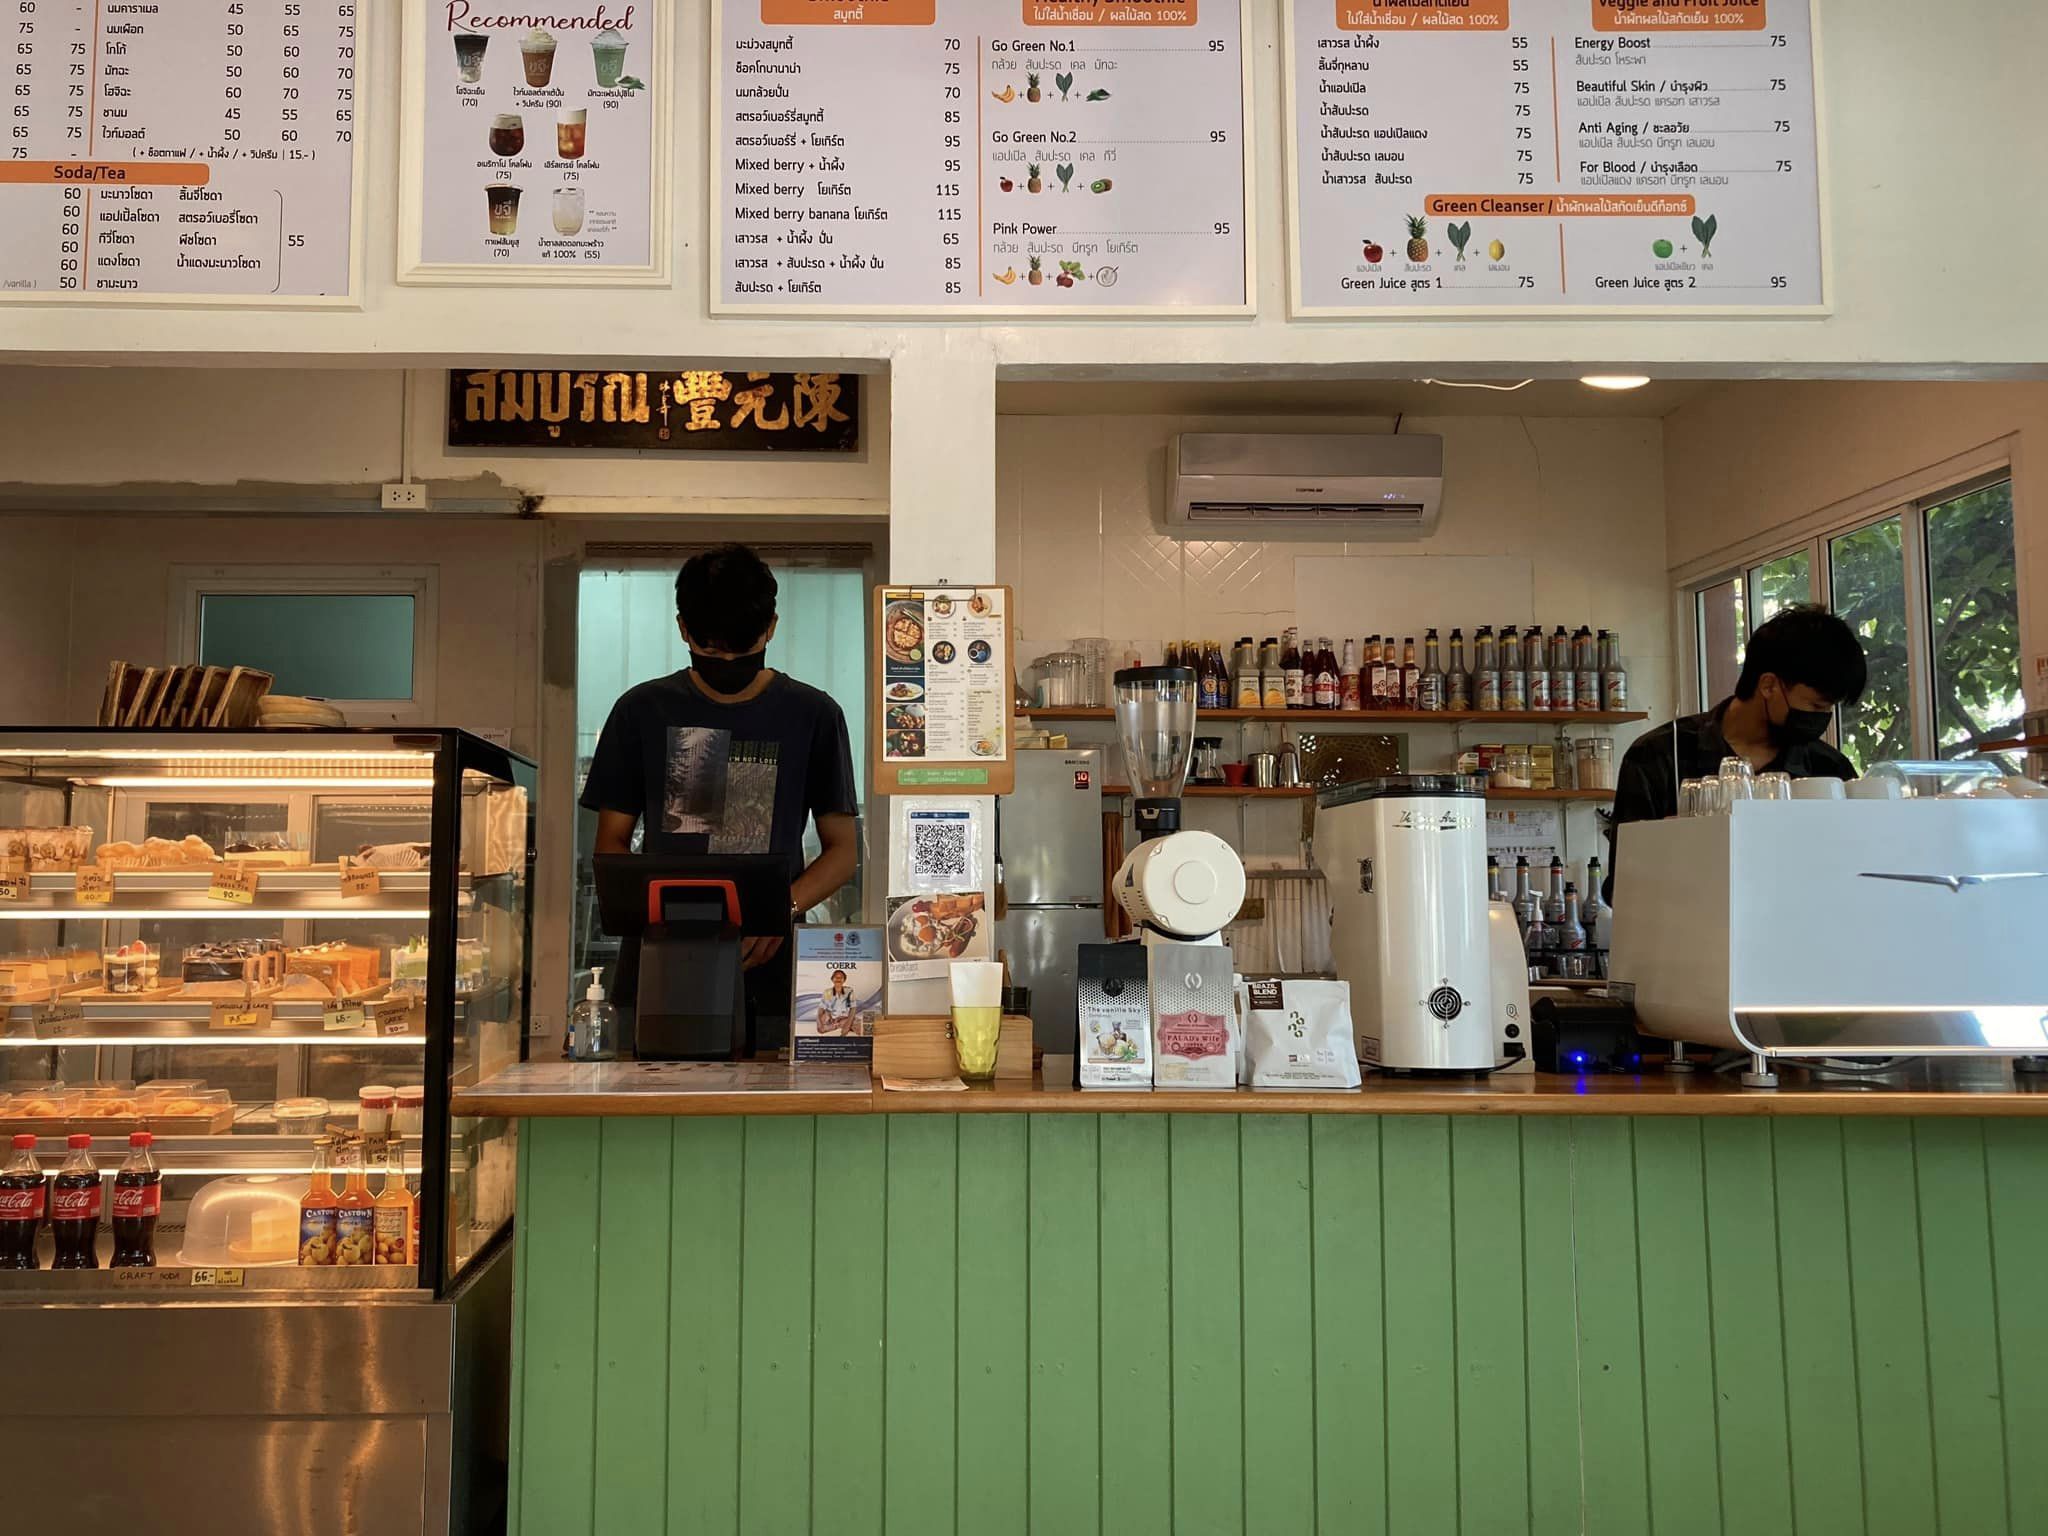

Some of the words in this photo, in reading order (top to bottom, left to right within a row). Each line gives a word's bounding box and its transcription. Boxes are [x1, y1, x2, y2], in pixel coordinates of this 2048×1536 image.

[108, 5, 158, 13] นมคาราเมล
[228, 4, 243, 14] 45
[1111, 7, 1151, 22] ผลไม้สด
[1157, 10, 1186, 22] 100%
[445, 0, 635, 33] Recommended
[1423, 11, 1463, 24] ผลไม้สด
[1469, 15, 1500, 24] 100%
[1712, 13, 1744, 24] 100%
[107, 24, 143, 33] นมเผือก
[228, 24, 243, 35] 50
[736, 36, 793, 52] มะม่วงสมูทตี้
[945, 39, 960, 50] 70
[992, 40, 1007, 51] Go
[1012, 40, 1045, 51] Green
[1050, 40, 1075, 51] No.1
[1208, 40, 1224, 52] 95
[1318, 40, 1349, 48] เสาวรส
[1354, 34, 1379, 48] น้ำผึ้ง
[1513, 37, 1528, 48] 55
[1575, 37, 1614, 51] Energy
[1619, 37, 1650, 48] Boost
[1771, 36, 1786, 46] 75
[106, 42, 126, 54] โกโก้
[227, 45, 242, 56] 50
[105, 65, 128, 75] มัทฉะ
[227, 66, 242, 77] 50
[945, 63, 960, 74] 75
[1319, 57, 1369, 74] ลิ้นจี่กุหลาบ
[1513, 60, 1528, 72] 55
[104, 84, 130, 96] โฮจิฉะ
[226, 87, 241, 98] 60
[736, 84, 788, 97] นมกล้วยปั่น
[945, 87, 960, 98] 70
[1320, 79, 1366, 93] น้ำแอปเปิล
[1514, 83, 1529, 93] 75
[1577, 80, 1626, 91] Beautiful
[1631, 80, 1656, 93] Skin
[1770, 79, 1786, 90] 75
[462, 98, 477, 107] (70)
[546, 98, 561, 109] (90)
[603, 100, 619, 109] (90)
[103, 109, 127, 117] ชานม
[225, 108, 240, 119] 45
[736, 108, 824, 125] สตรอว์เบอร์รี่สมูทตี้
[945, 111, 960, 122] 85
[102, 125, 145, 138] ไวท์มอลต์
[225, 129, 240, 140] 50
[1321, 124, 1369, 138] น้ำสับปะรด
[1374, 128, 1427, 138] แอปเปิลแดง
[1516, 128, 1531, 139] 75
[1579, 122, 1601, 133] Anti
[1607, 122, 1638, 136] Aging
[1775, 121, 1790, 132] 75
[736, 133, 796, 145] สตรอว์เบอร์รี่
[811, 133, 844, 146] โยเกิร์ต
[945, 136, 960, 147] 95
[993, 131, 1008, 142] Go
[1013, 131, 1046, 142] Green
[1051, 131, 1076, 142] No.2
[1211, 131, 1225, 143] 95
[736, 159, 769, 170] Mixed
[774, 159, 804, 173] berry
[819, 157, 844, 170] น้ำผึ้ง
[945, 160, 960, 171] 95
[1581, 161, 1598, 172] For
[1603, 161, 1635, 172] Blood
[1776, 161, 1791, 171] 75
[54, 165, 125, 180] Soda/Tea
[496, 171, 511, 179] (75)
[564, 172, 580, 181] (75)
[1323, 170, 1366, 184] น้ำเสาวรส
[1375, 173, 1412, 184] สับปะรด
[1518, 173, 1533, 184] 75
[101, 187, 152, 199] มะนาวโซดา
[180, 186, 222, 200] ลิ้นจี่โซดา
[1433, 200, 1477, 212] Green
[1481, 199, 1544, 212] Cleanser
[100, 209, 159, 222] แอปเปิ้ลโซดา
[736, 208, 769, 219] Mixed
[774, 207, 804, 222] berry
[809, 208, 849, 219] banana
[855, 206, 887, 219] โยเกิร์ต
[939, 209, 961, 220] 115
[994, 223, 1017, 234] Pink
[1023, 223, 1056, 234] Power
[1215, 223, 1229, 234] 95
[99, 230, 134, 244] กีวี่โซดา
[180, 233, 216, 245] พีชโซดา
[288, 235, 304, 246] 55
[736, 235, 767, 243] เสาวรส
[787, 229, 812, 243] น้ำผึ้ง
[819, 230, 832, 244] ปั่น
[944, 233, 959, 244] 65
[494, 249, 509, 257] (70)
[553, 249, 576, 259] 100%
[98, 254, 140, 266] แดงโซดา
[177, 254, 260, 268] น้ำแดงมะนาวโซดา
[97, 280, 137, 288] ชามะนาว
[1342, 278, 1374, 289] Green
[1379, 277, 1406, 288] Juice
[1436, 277, 1442, 288] 1
[1519, 277, 1534, 287] 75
[1076, 772, 1088, 781] 10
[826, 962, 857, 970] COERR
